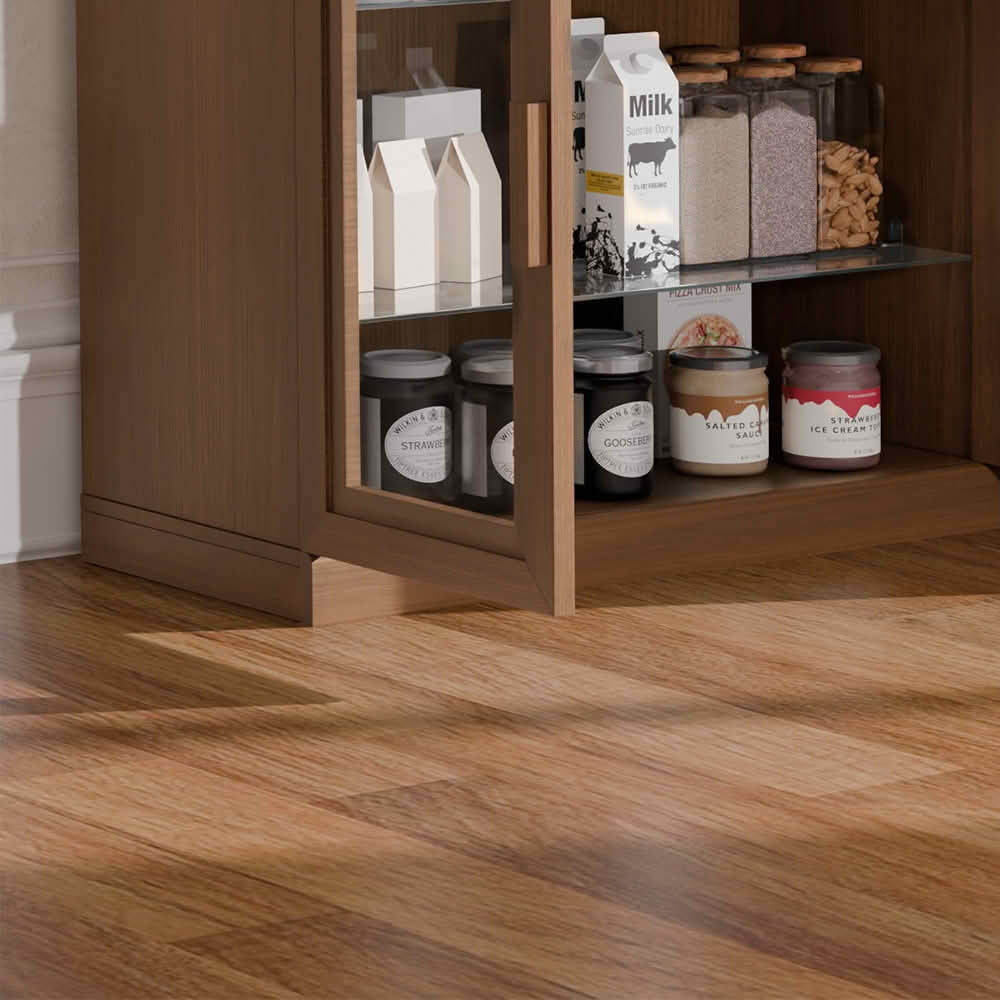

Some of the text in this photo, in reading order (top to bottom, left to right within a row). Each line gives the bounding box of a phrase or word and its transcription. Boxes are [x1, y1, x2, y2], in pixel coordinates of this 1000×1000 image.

[629, 93, 673, 118] Milk
[705, 422, 746, 430] SALTED
[810, 426, 828, 434] ICE
[832, 424, 866, 434] CREAM
